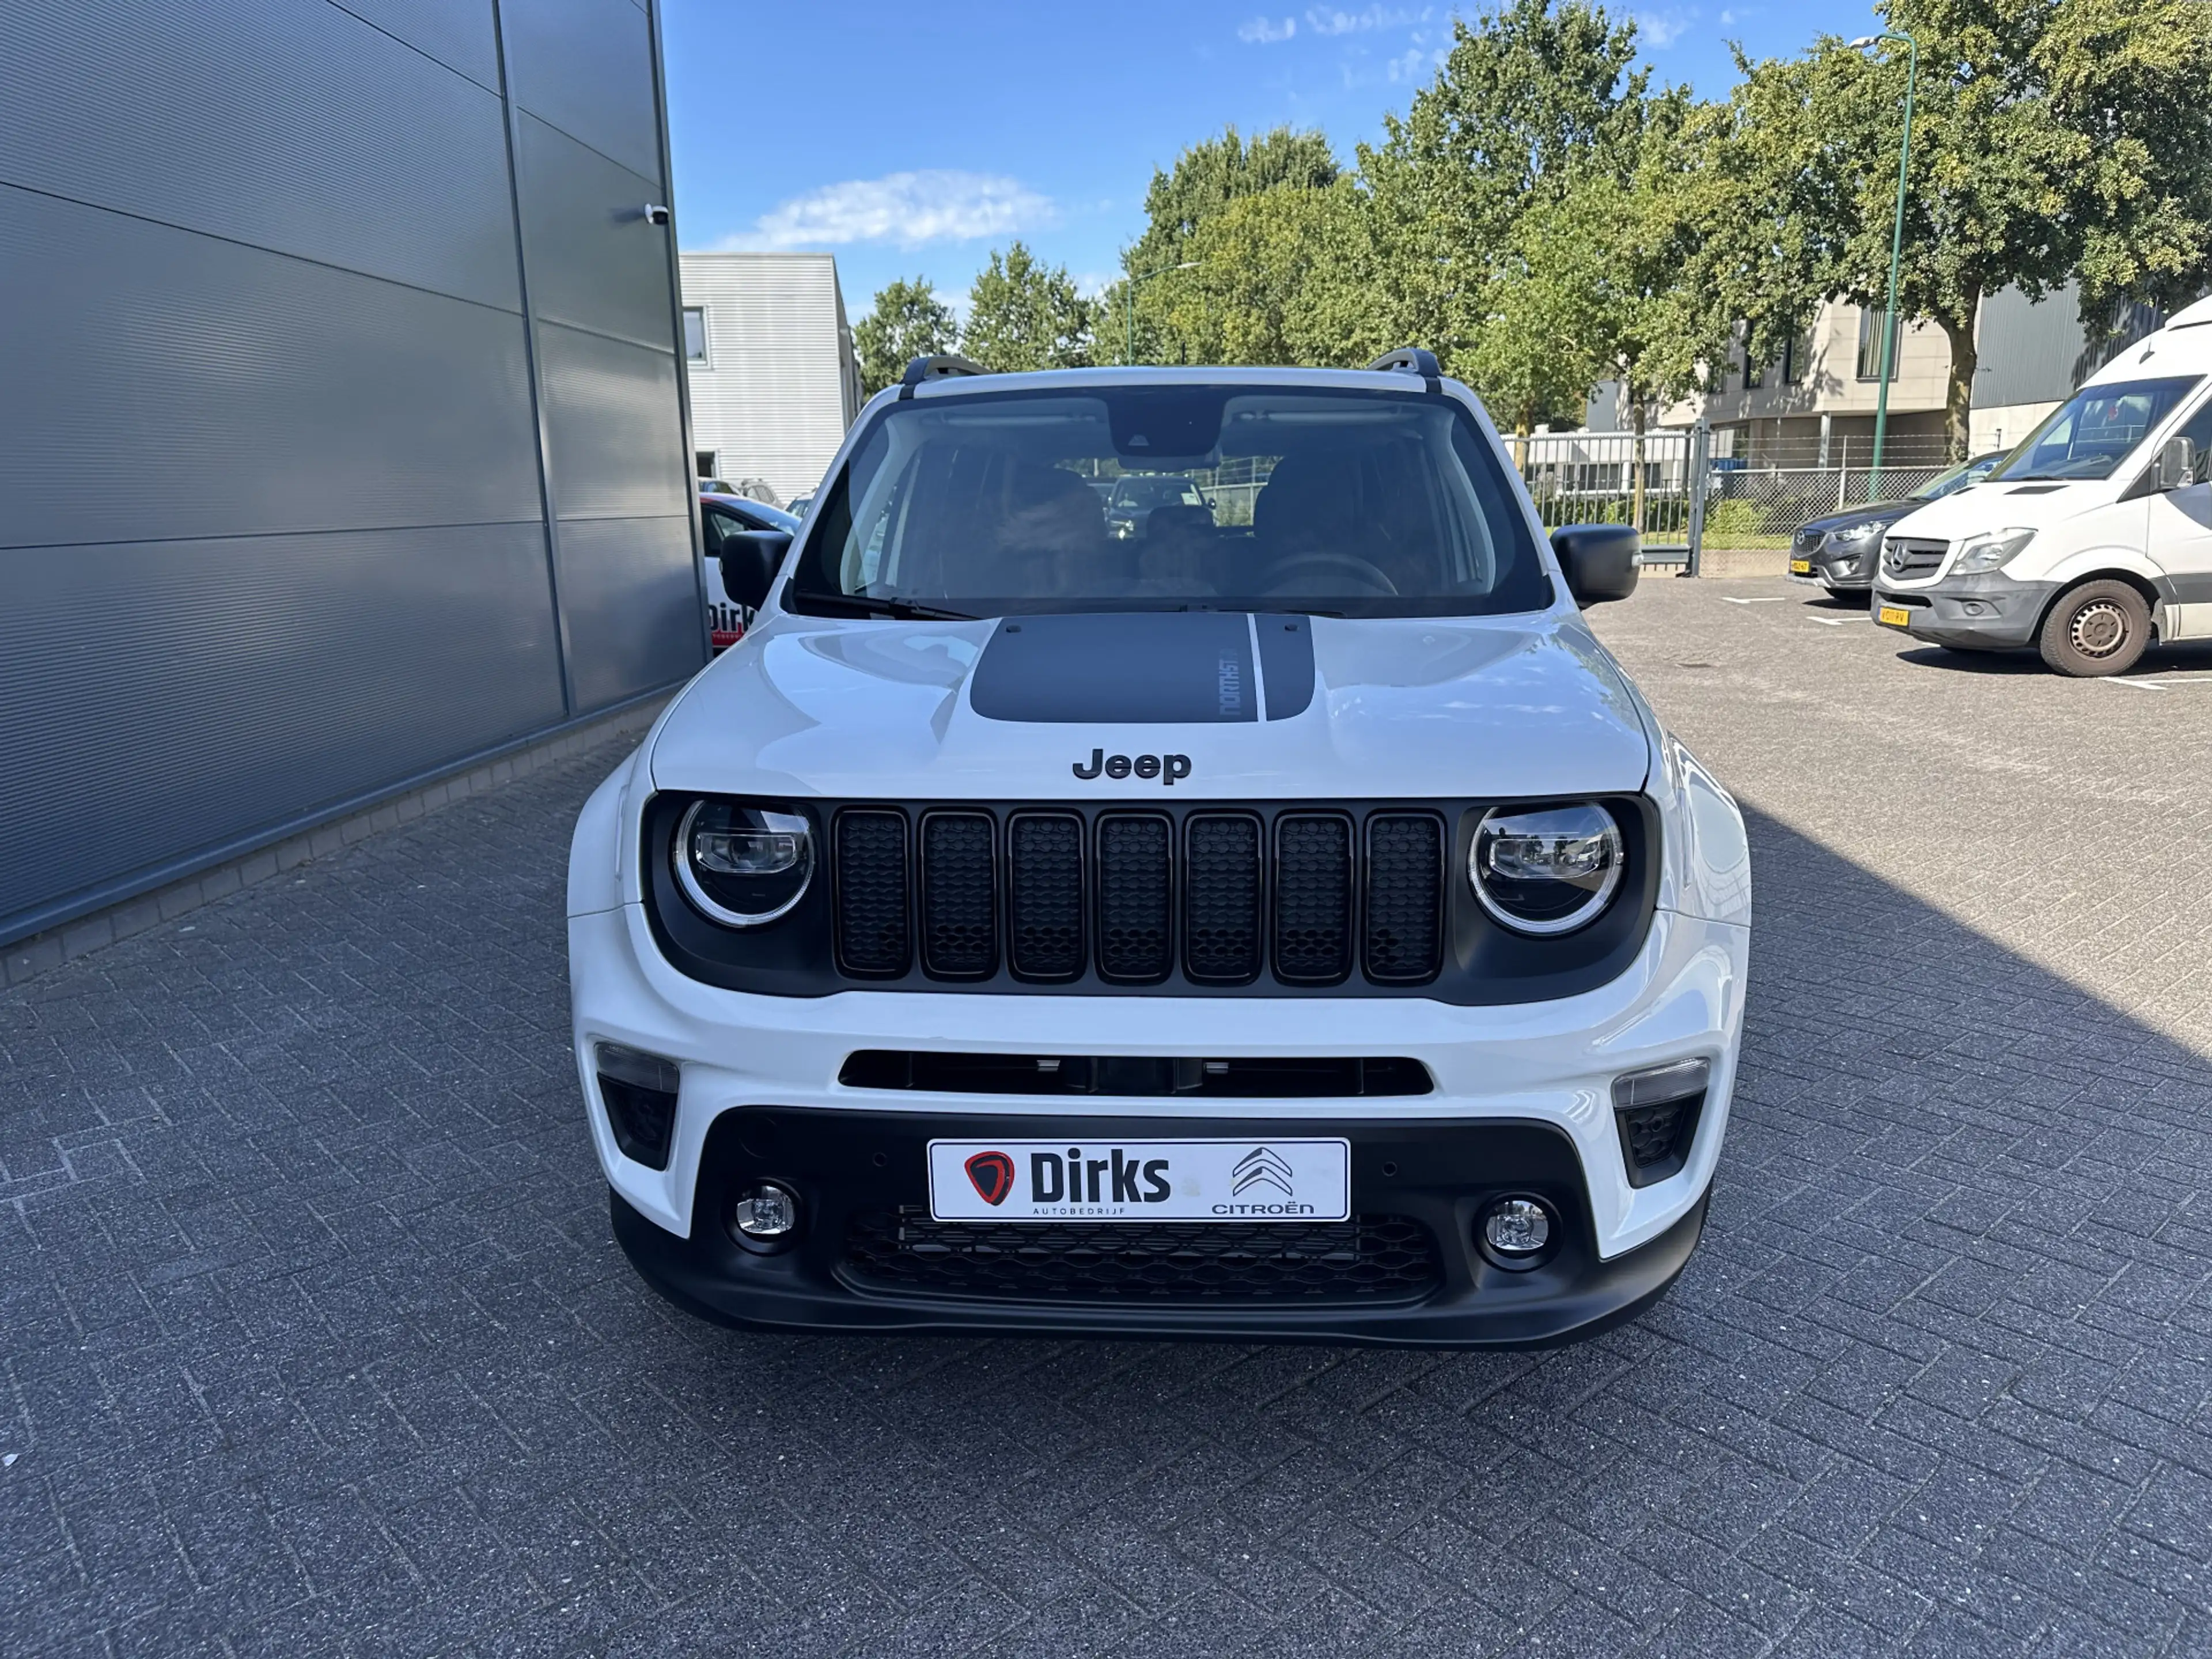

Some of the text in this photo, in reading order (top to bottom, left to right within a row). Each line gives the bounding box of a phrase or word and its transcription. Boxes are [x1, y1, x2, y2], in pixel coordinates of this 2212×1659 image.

[1073, 749, 1192, 785] Jeep
[1031, 1147, 1171, 1203] Dirks
[1212, 1201, 1315, 1214] CITROËN
